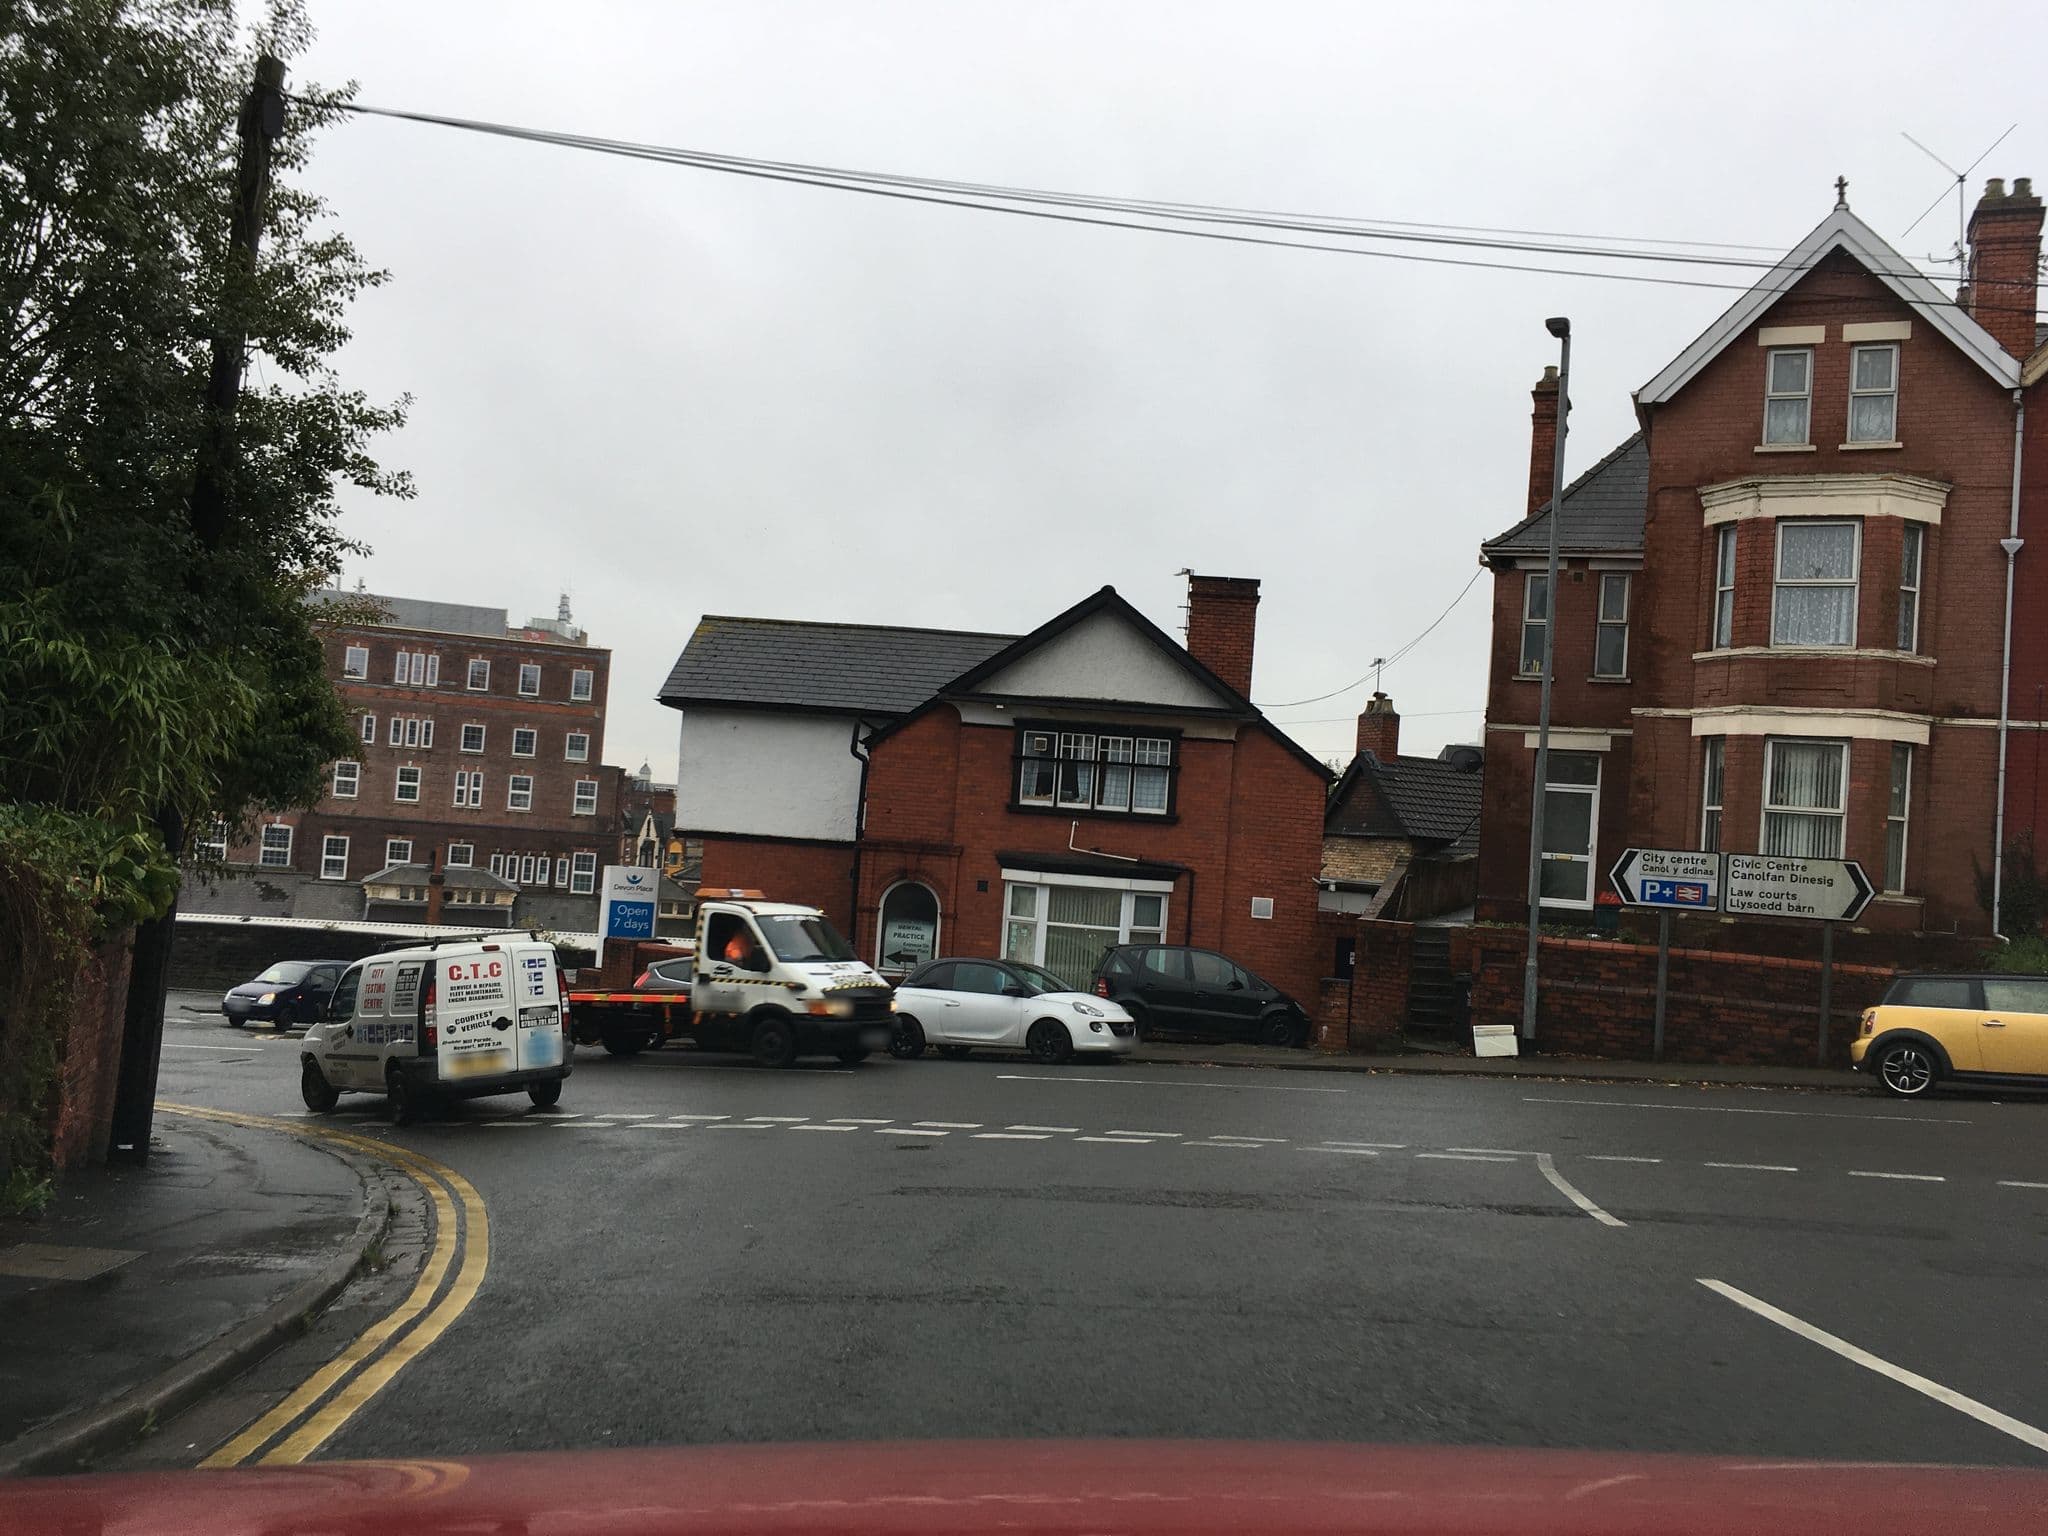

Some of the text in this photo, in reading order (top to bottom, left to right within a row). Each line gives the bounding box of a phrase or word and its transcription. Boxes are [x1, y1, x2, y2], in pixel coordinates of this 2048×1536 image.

[1642, 853, 1707, 865] City centre
[1732, 859, 1807, 872] Civic Centre
[1642, 864, 1714, 876] Canol y ddinas
[1732, 870, 1834, 887] Canolfan Dinesig
[1645, 881, 1660, 900] P
[1731, 887, 1797, 900] Law courts
[617, 904, 648, 918] Open
[1730, 899, 1815, 913] Llysoedd barn
[614, 917, 649, 932] 7 days
[893, 932, 925, 940] PRACTICE
[448, 962, 502, 981] C.T.C
[455, 1010, 493, 1025] COURTESY
[461, 1020, 491, 1032] VEHICLE
